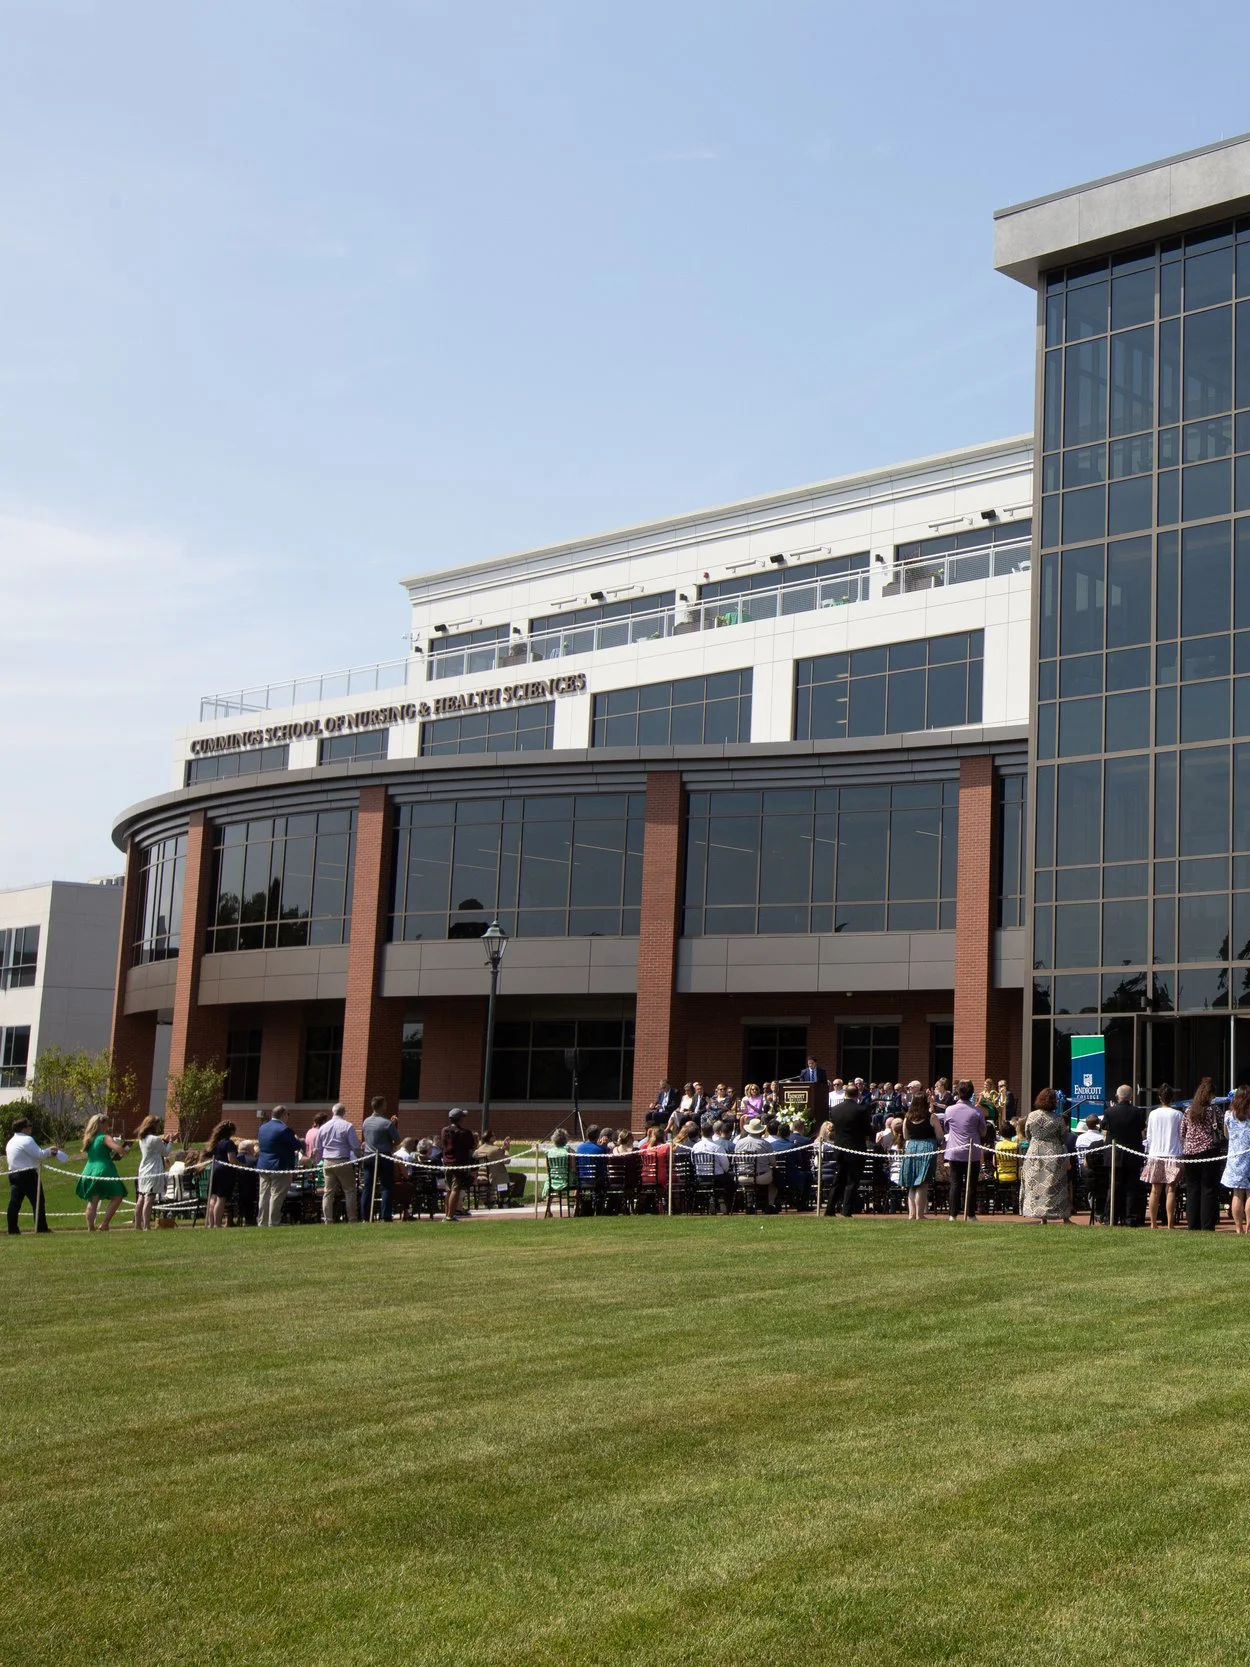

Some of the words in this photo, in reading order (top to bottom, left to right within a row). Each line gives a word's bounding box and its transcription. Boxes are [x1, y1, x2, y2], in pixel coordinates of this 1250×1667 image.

[190, 729, 264, 755] CUMMINGS
[264, 719, 323, 742] SCHOOL
[323, 715, 346, 733] OF
[346, 703, 417, 729] NURSING
[417, 702, 431, 717] &
[432, 687, 502, 715] HEALTH
[502, 673, 586, 703] SCIENCES
[1074, 1084, 1102, 1095] ENDICOTT
